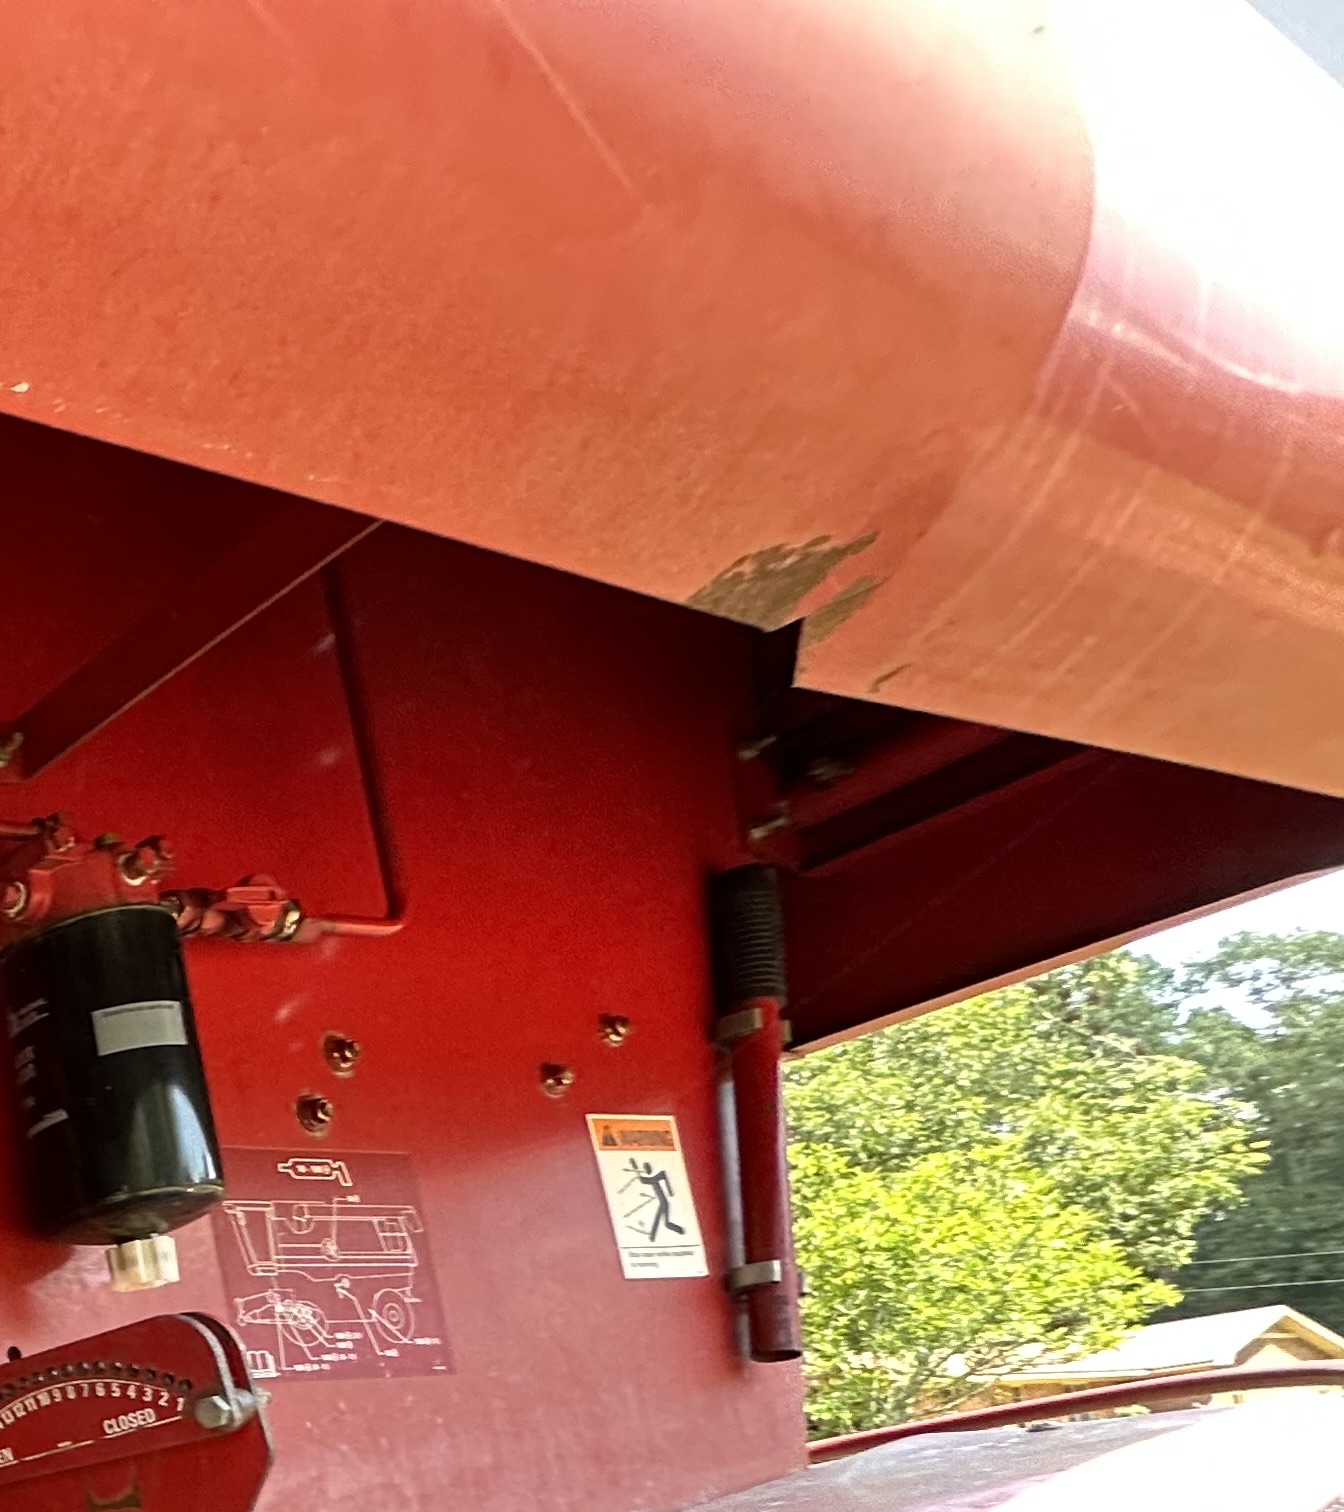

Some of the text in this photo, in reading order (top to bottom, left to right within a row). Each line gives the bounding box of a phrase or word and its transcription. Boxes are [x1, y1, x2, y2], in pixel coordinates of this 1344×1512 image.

[52, 1388, 62, 1402] 9
[66, 1385, 76, 1399] 8
[80, 1383, 89, 1397] 7
[95, 1383, 105, 1397] 6
[112, 1383, 121, 1397] 5
[127, 1385, 136, 1399] 4
[142, 1387, 153, 1401] 3
[158, 1391, 170, 1407] 2
[177, 1397, 185, 1411] 1
[103, 1408, 156, 1434] CLOSED
